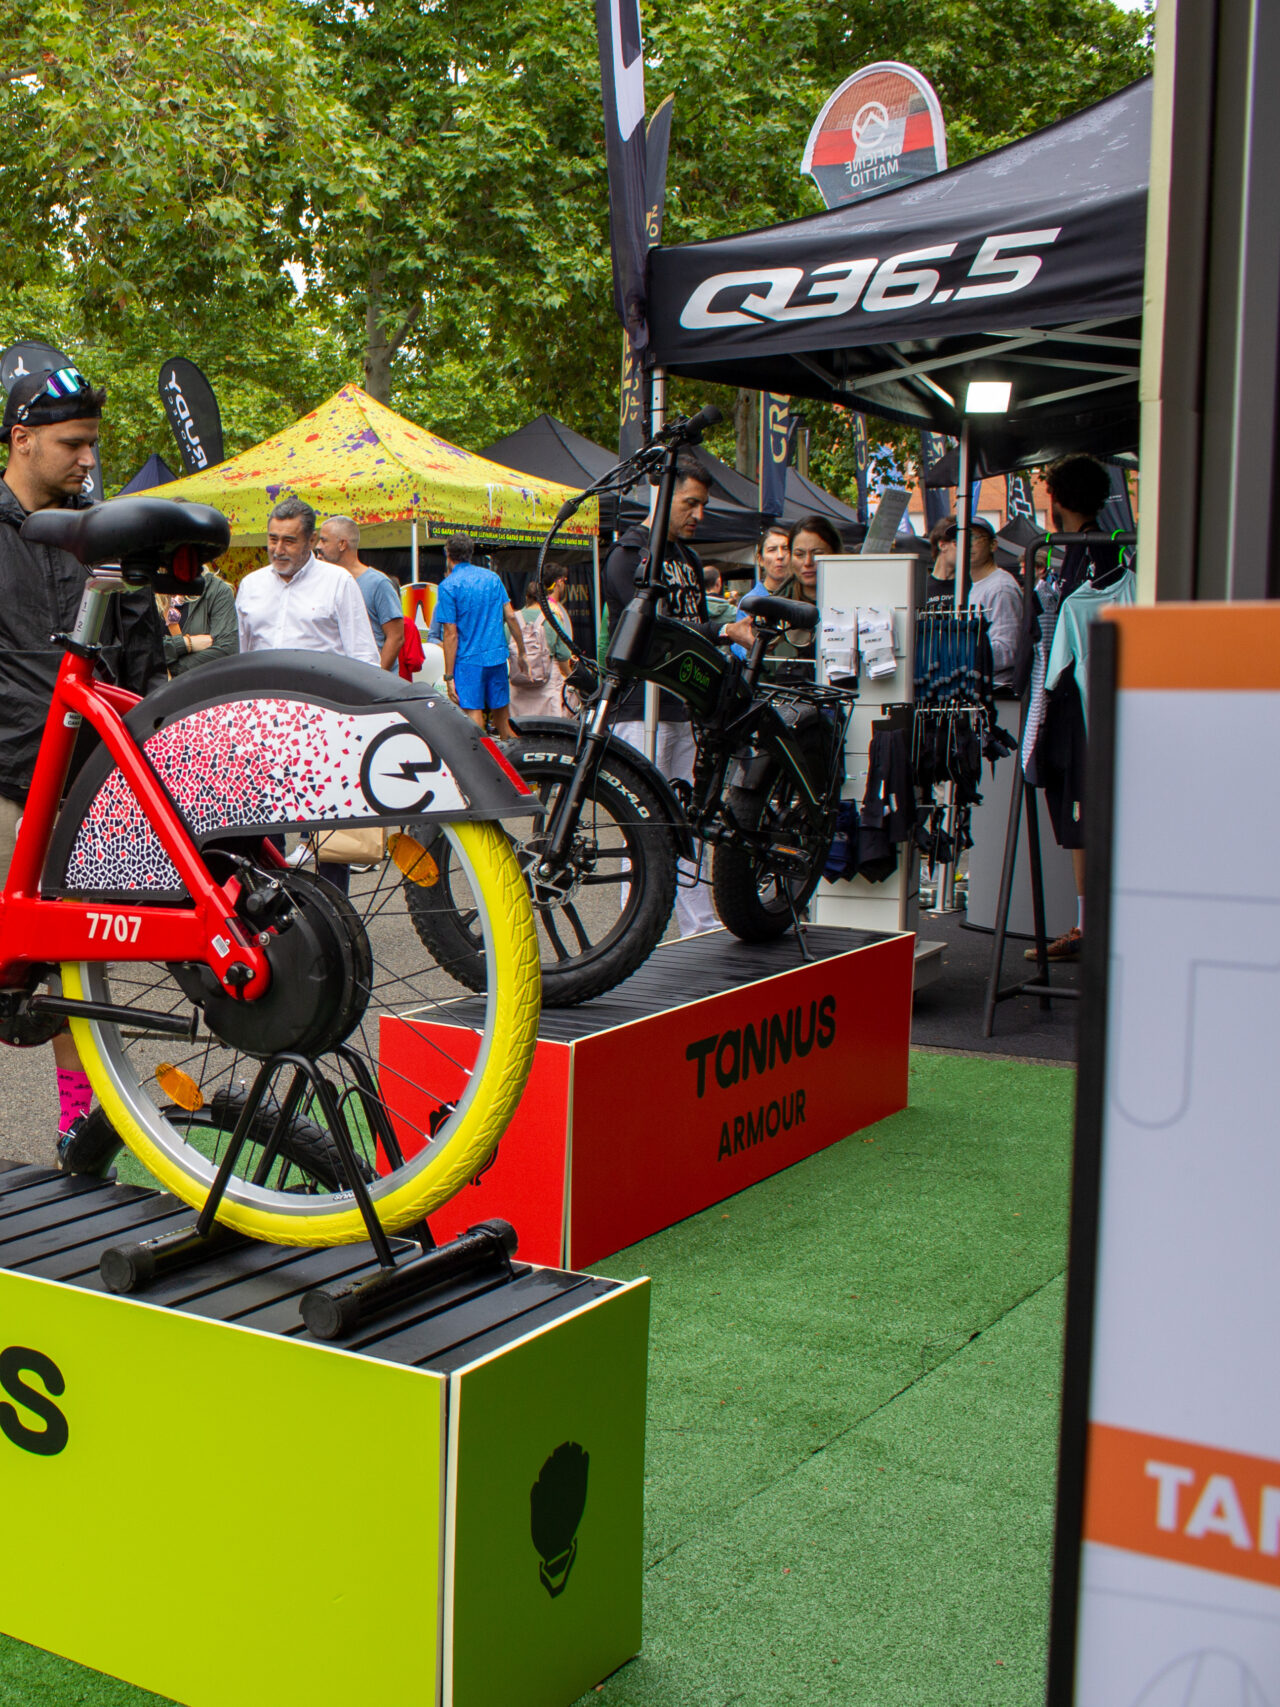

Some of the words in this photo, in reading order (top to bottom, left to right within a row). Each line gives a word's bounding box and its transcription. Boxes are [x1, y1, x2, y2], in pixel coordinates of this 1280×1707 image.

[680, 228, 1062, 329] Q36.5
[522, 752, 558, 762] CST
[86, 912, 142, 943] 7707
[717, 1088, 806, 1162] ARMOUR
